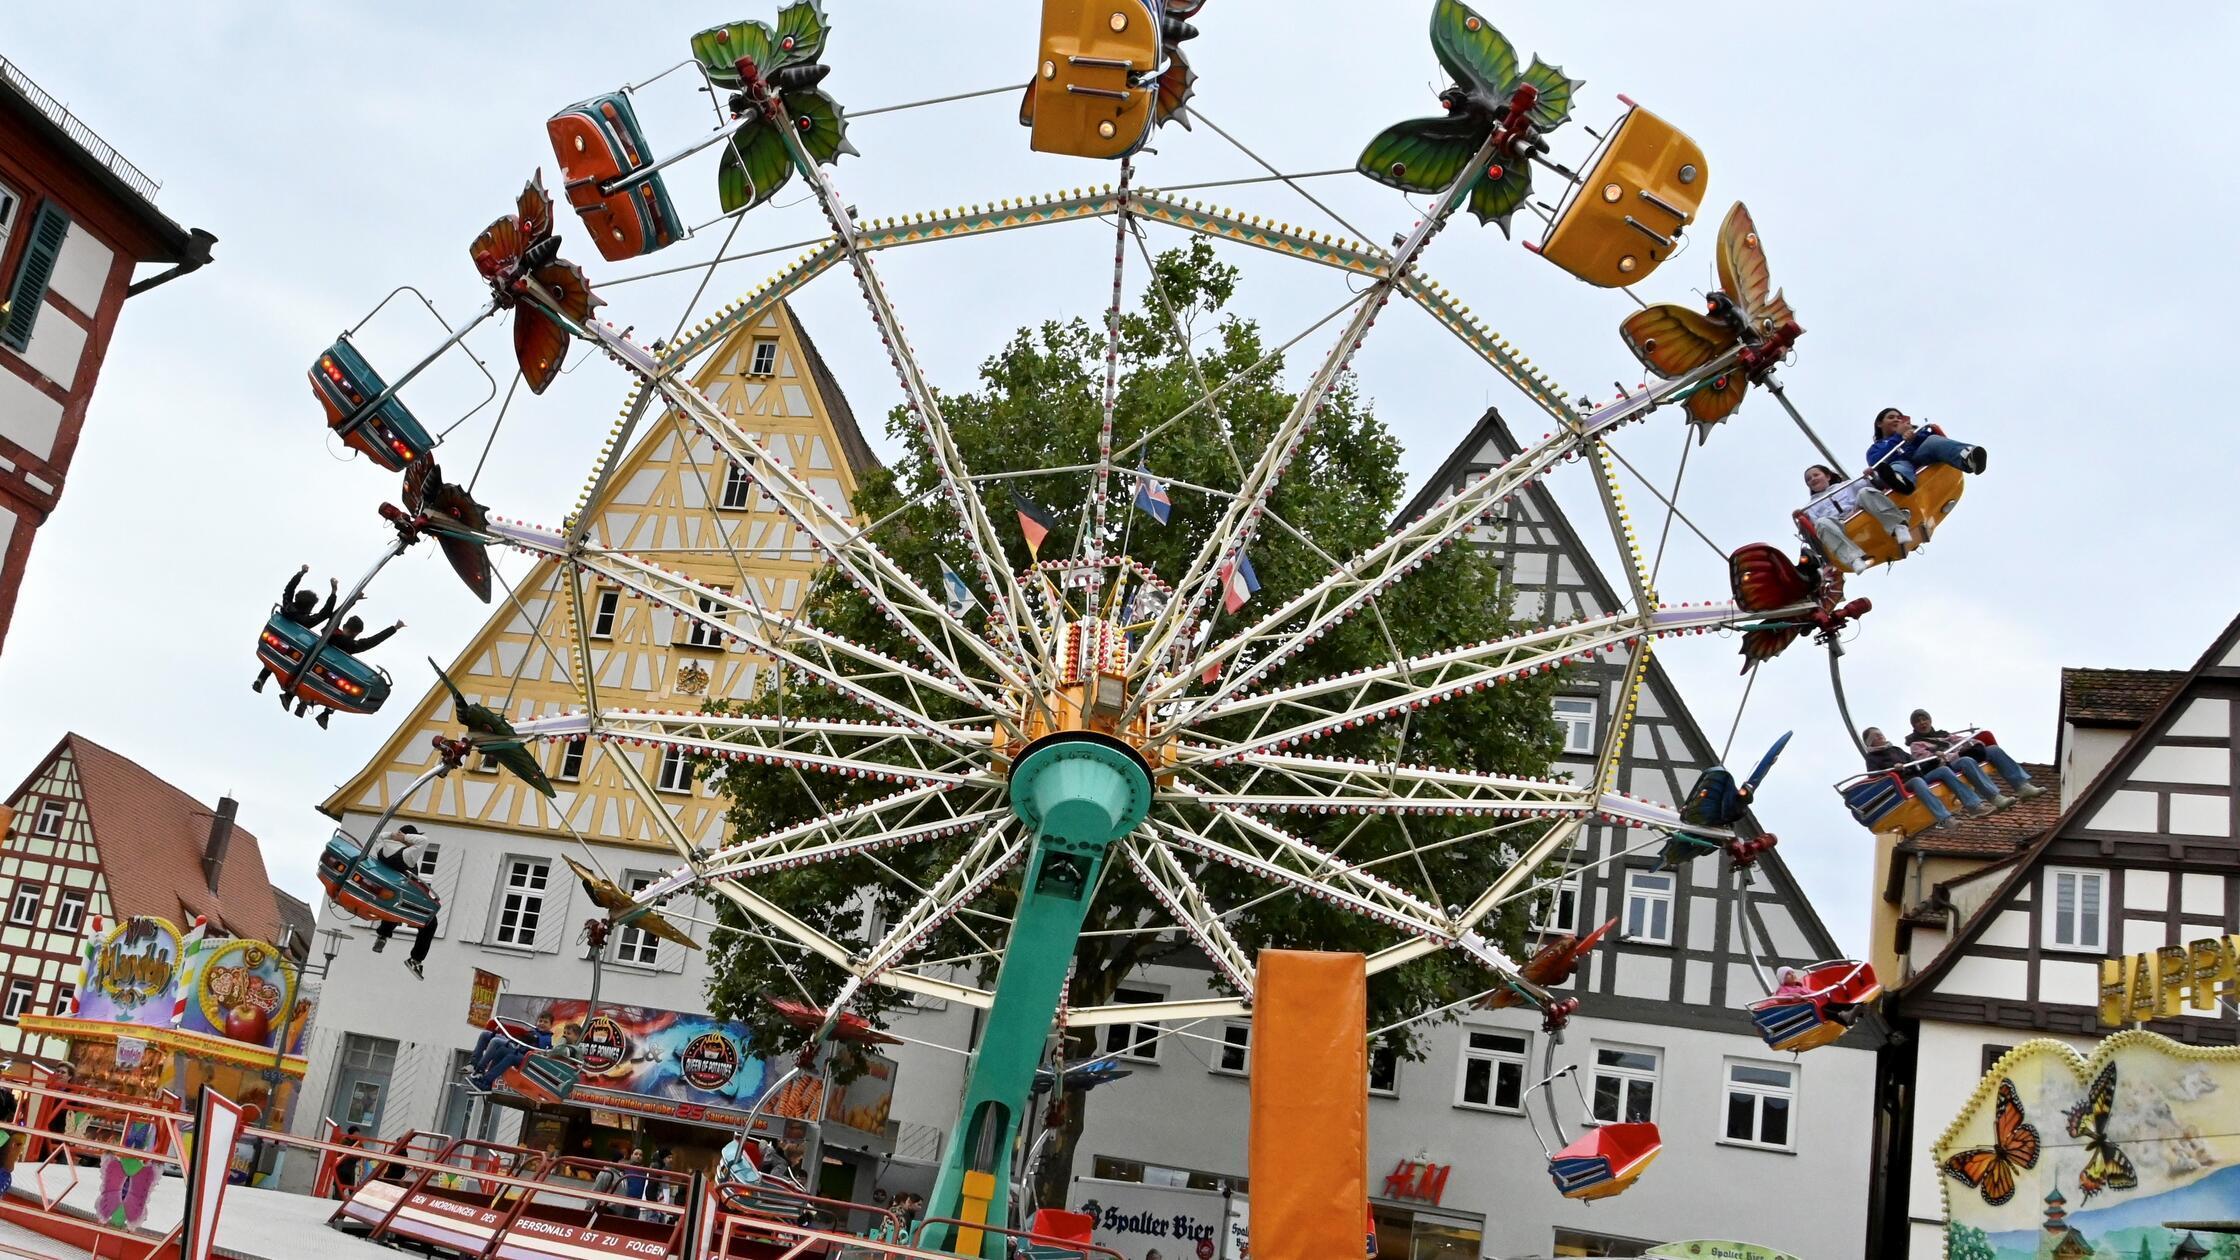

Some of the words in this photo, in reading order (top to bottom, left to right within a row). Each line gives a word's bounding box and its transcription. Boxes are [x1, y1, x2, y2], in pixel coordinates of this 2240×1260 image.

[590, 1044, 597, 1055] OF
[597, 1044, 620, 1061] POMMES
[685, 1058, 702, 1072] QUEEN
[702, 1060, 709, 1071] OF
[709, 1061, 732, 1078] POTATOES
[675, 1103, 707, 1121] 25
[1383, 1158, 1451, 1206] H&M
[411, 1194, 427, 1205] DEN
[428, 1199, 476, 1218] ANORDNUNGEN
[480, 1213, 497, 1223] DES
[515, 1219, 574, 1238] PERSONALS
[580, 1232, 599, 1243] IST
[602, 1235, 618, 1247] ZU
[625, 1240, 666, 1257] FOLGEN
[1102, 1206, 1169, 1238] Spalter
[1171, 1215, 1214, 1242] Bier
[1231, 1222, 1249, 1236] Spal
